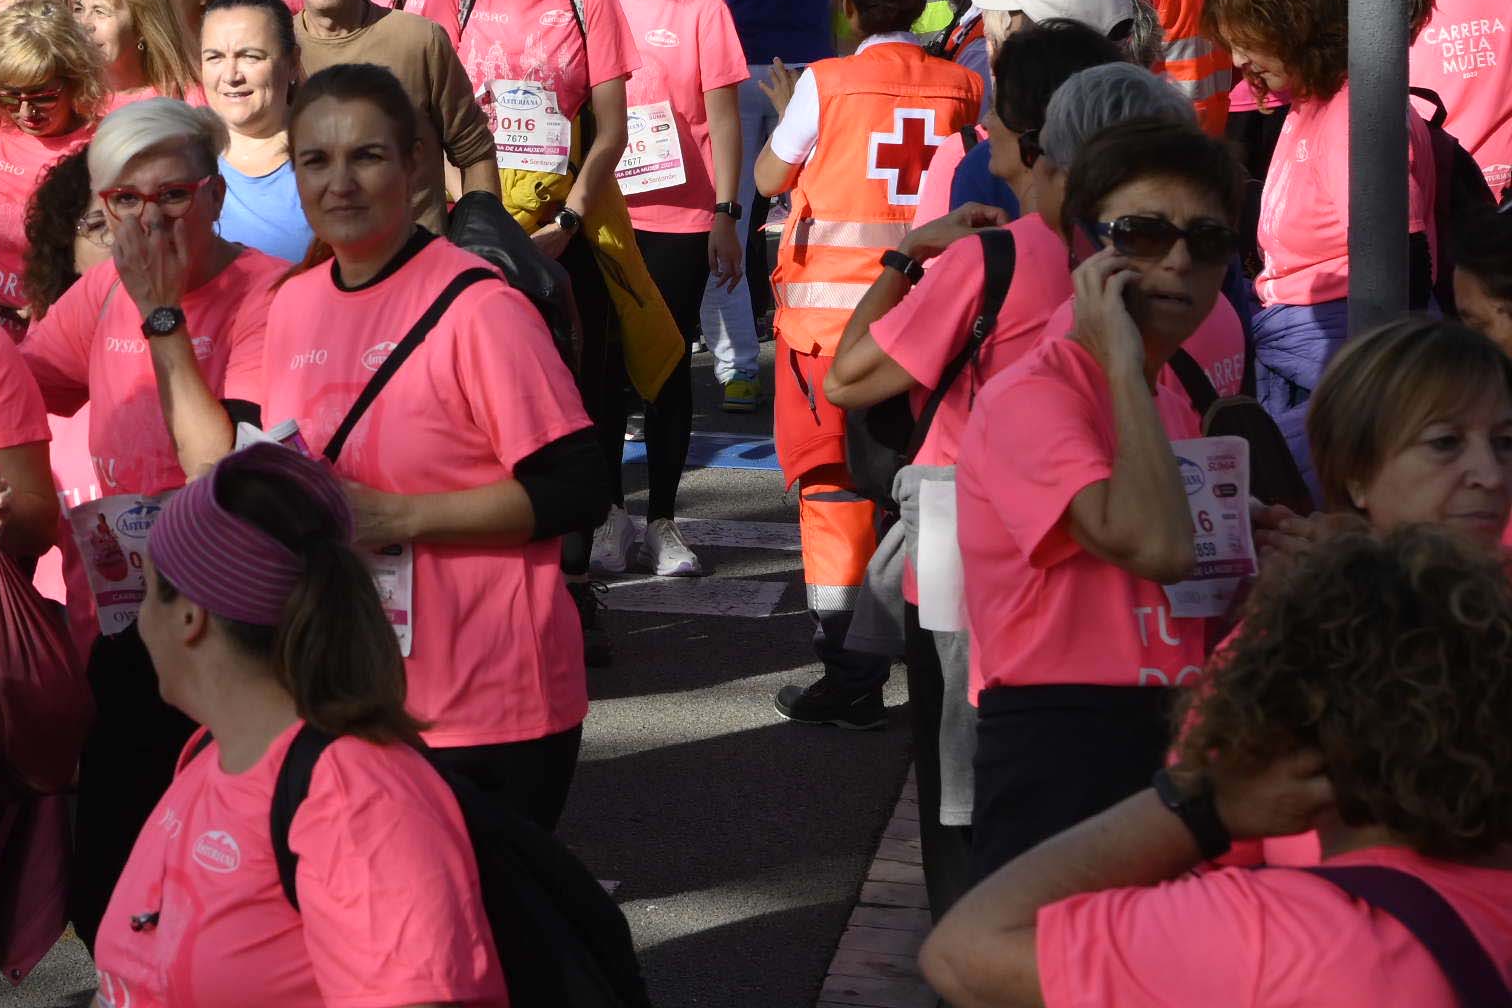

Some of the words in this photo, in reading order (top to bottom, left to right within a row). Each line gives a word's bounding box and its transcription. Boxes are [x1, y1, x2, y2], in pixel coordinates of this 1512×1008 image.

[1424, 18, 1506, 45] CARRERA
[1442, 43, 1465, 58] DE
[1469, 36, 1492, 52] LA
[1442, 51, 1497, 75] MUJER
[501, 117, 536, 131] 016
[506, 134, 528, 143] 7679
[1134, 605, 1181, 647] TU
